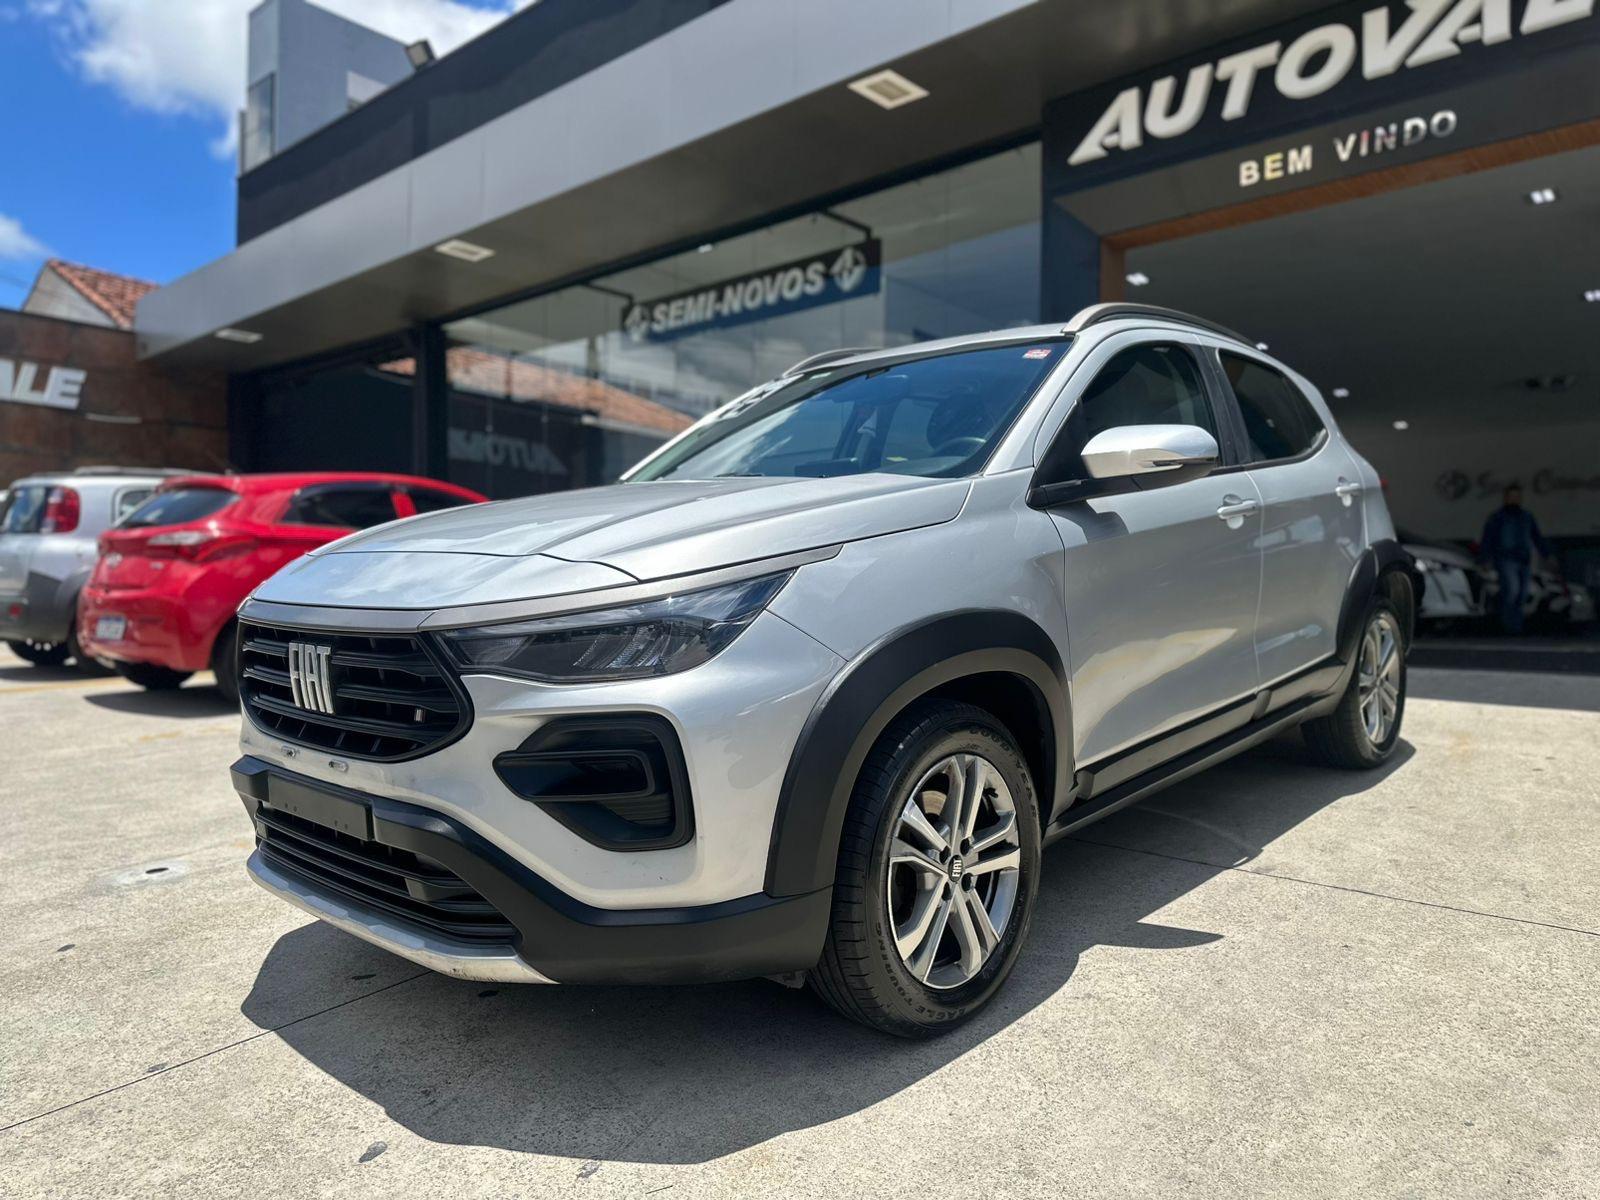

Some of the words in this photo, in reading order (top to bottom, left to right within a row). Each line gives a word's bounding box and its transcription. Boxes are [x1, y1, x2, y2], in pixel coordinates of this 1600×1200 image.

[1239, 144, 1313, 187] BEM
[1333, 109, 1458, 162] VINDO
[651, 261, 826, 333] SEMI-NOVOS
[288, 639, 335, 715] FIAT
[951, 859, 962, 877] FIAT
